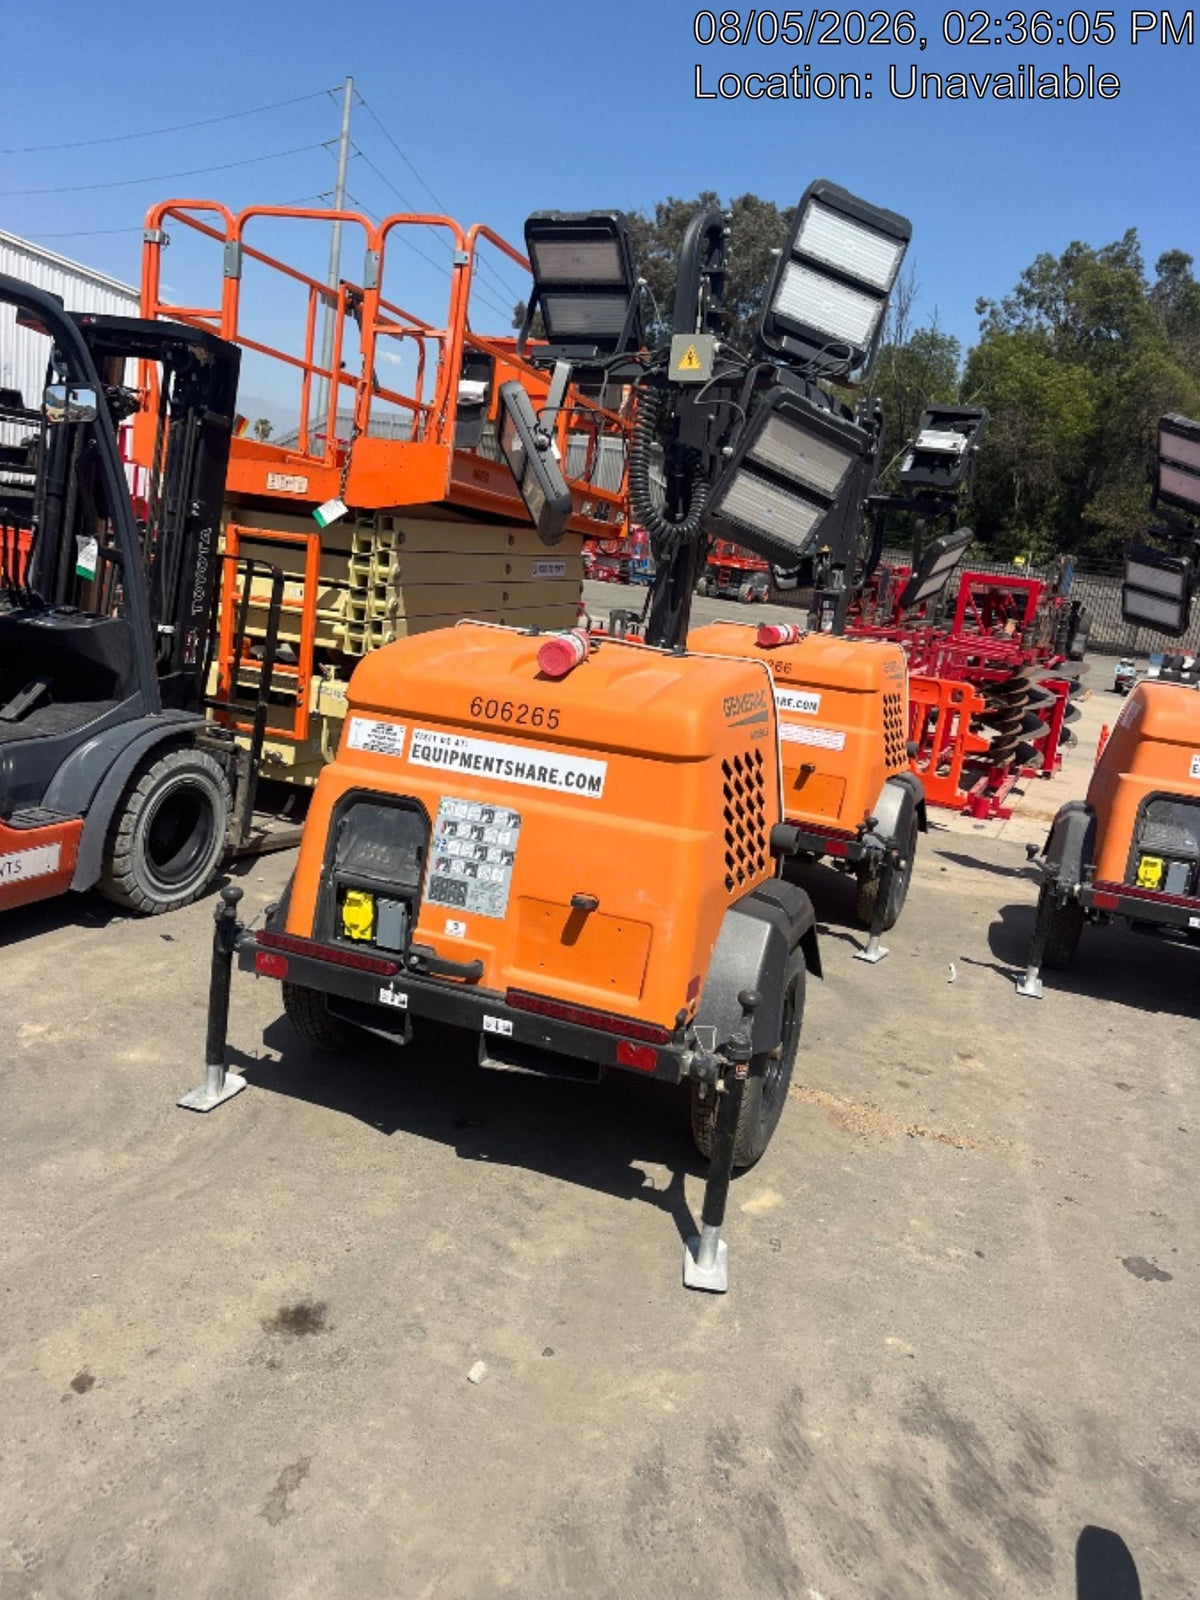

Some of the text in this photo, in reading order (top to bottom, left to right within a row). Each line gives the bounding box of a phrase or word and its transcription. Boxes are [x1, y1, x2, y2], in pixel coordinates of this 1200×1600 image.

[191, 527, 213, 616] TOYOTA
[470, 696, 560, 730] 606265
[722, 689, 768, 717] GENERAC
[410, 743, 602, 793] EQUIPMENTSHARE.COM
